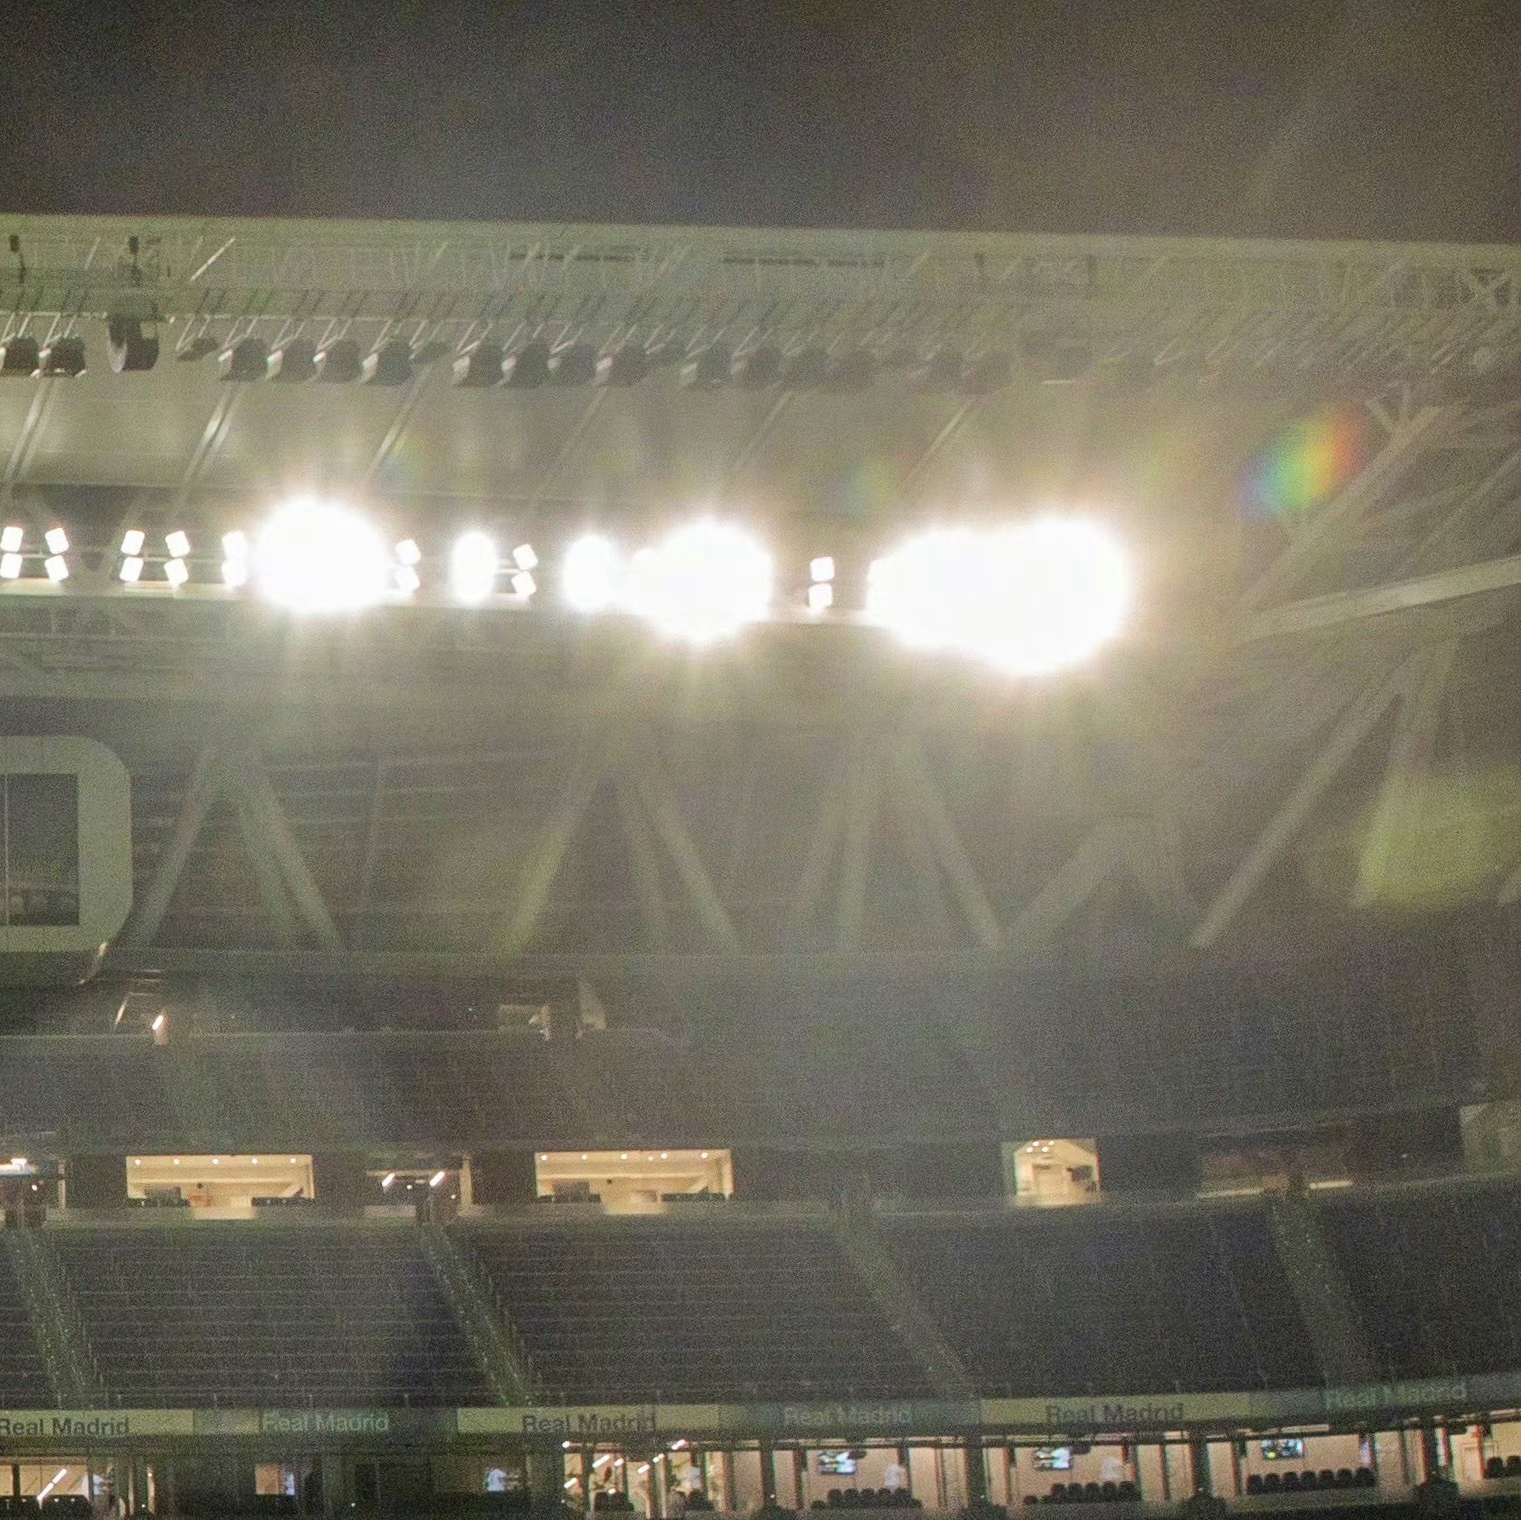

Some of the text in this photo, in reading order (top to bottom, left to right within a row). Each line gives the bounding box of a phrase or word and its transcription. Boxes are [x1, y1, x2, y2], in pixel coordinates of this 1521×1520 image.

[262, 1412, 389, 1431] Real Madrid
[523, 1414, 655, 1433] Real Madrid
[1046, 1405, 1094, 1424] Real
[52, 1418, 129, 1436] Madrid
